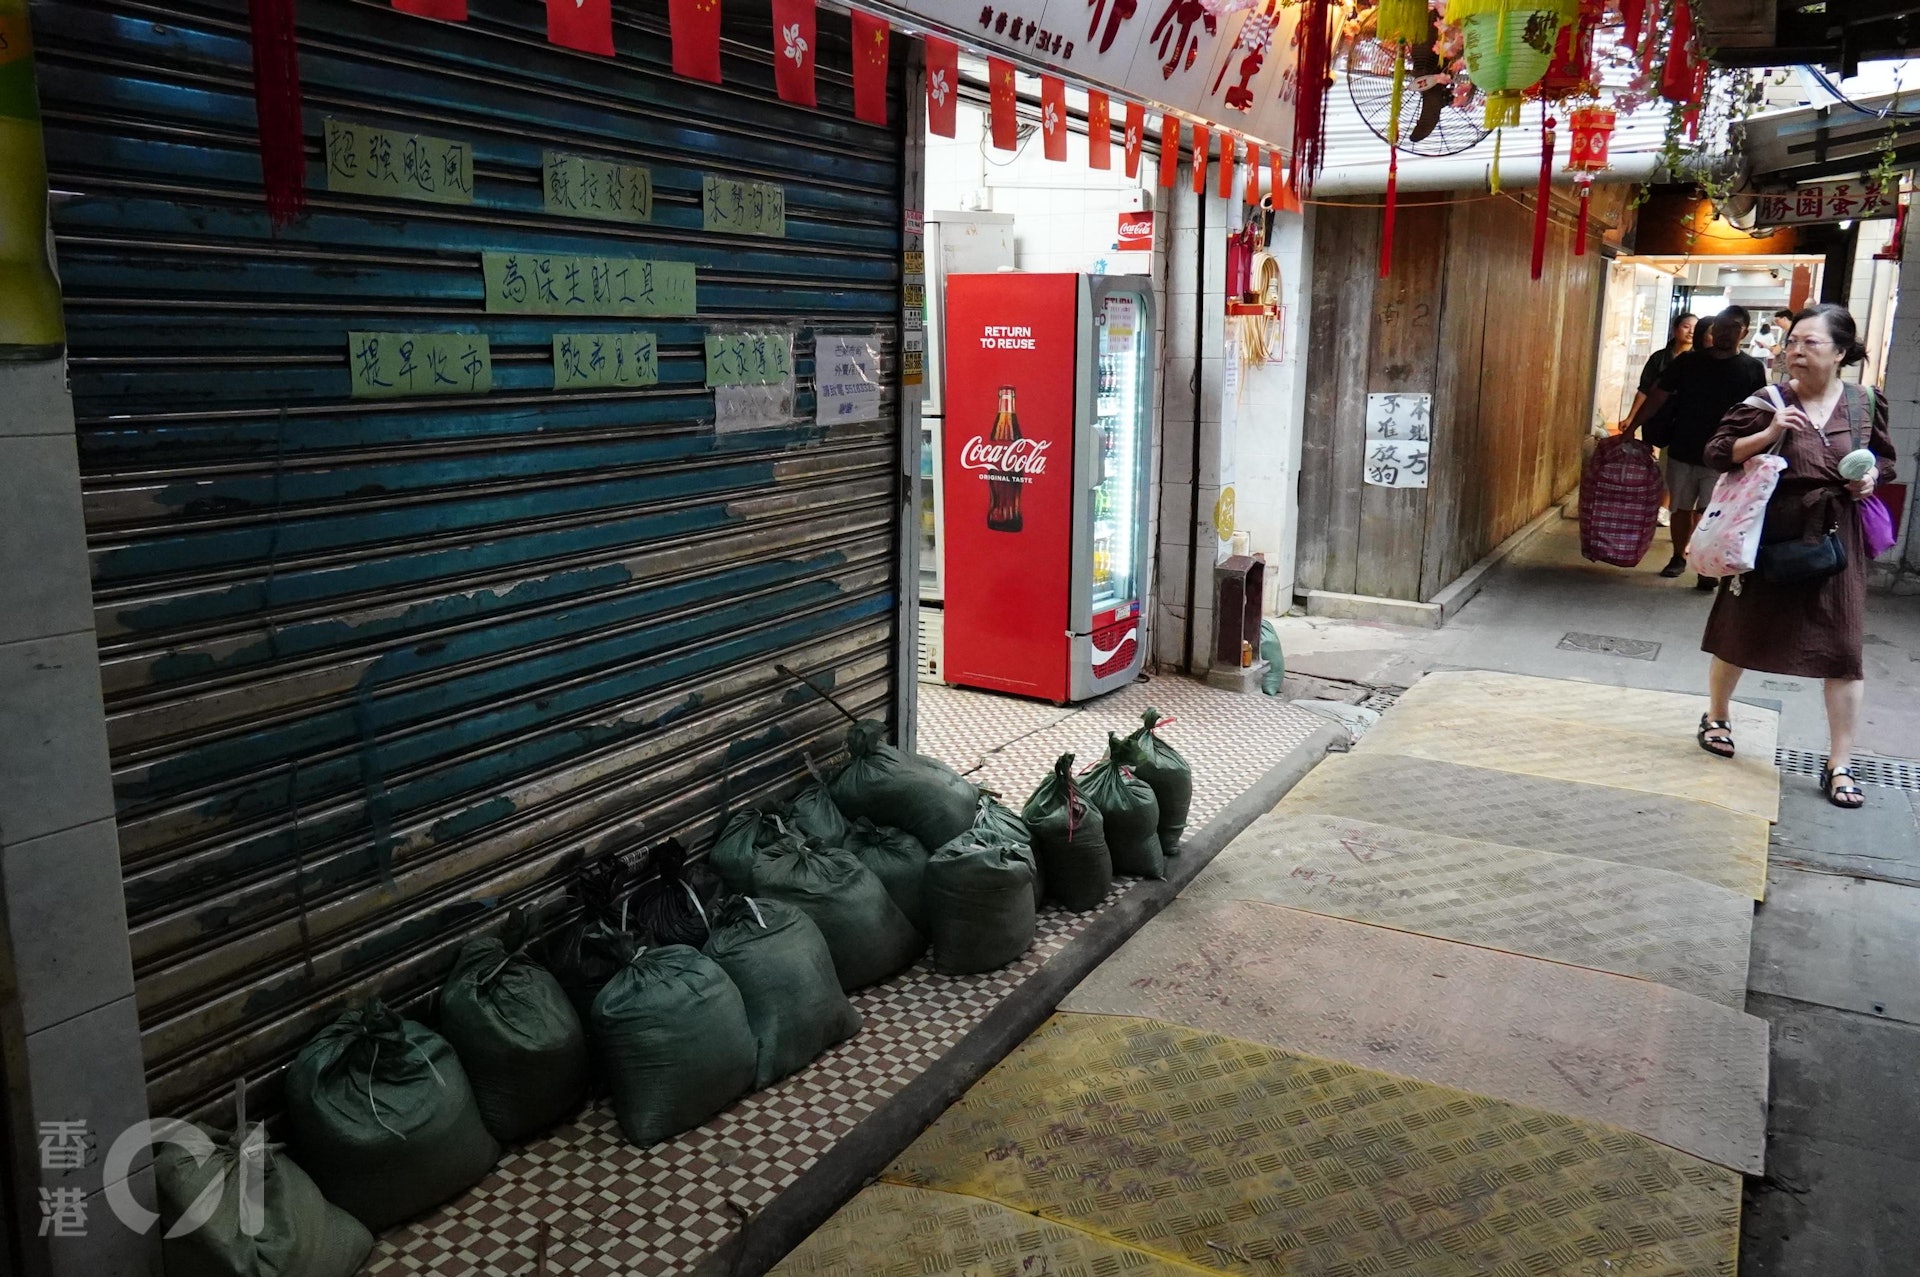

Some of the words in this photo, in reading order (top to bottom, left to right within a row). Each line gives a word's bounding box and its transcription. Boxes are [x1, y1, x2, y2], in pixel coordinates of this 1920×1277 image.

[329, 125, 471, 193] 超強颱風
[980, 338, 995, 350] TO
[996, 338, 1036, 350] REUSE
[984, 327, 1031, 338] RETURN
[356, 338, 483, 391] 提早收市
[713, 338, 789, 376] 大家撐住
[960, 435, 1052, 475] Coca-Cola
[1370, 394, 1402, 485] 不准放狗
[1403, 396, 1430, 475] 本地方
[978, 474, 1009, 483] ORIGINAL
[1011, 476, 1033, 484] TASTE
